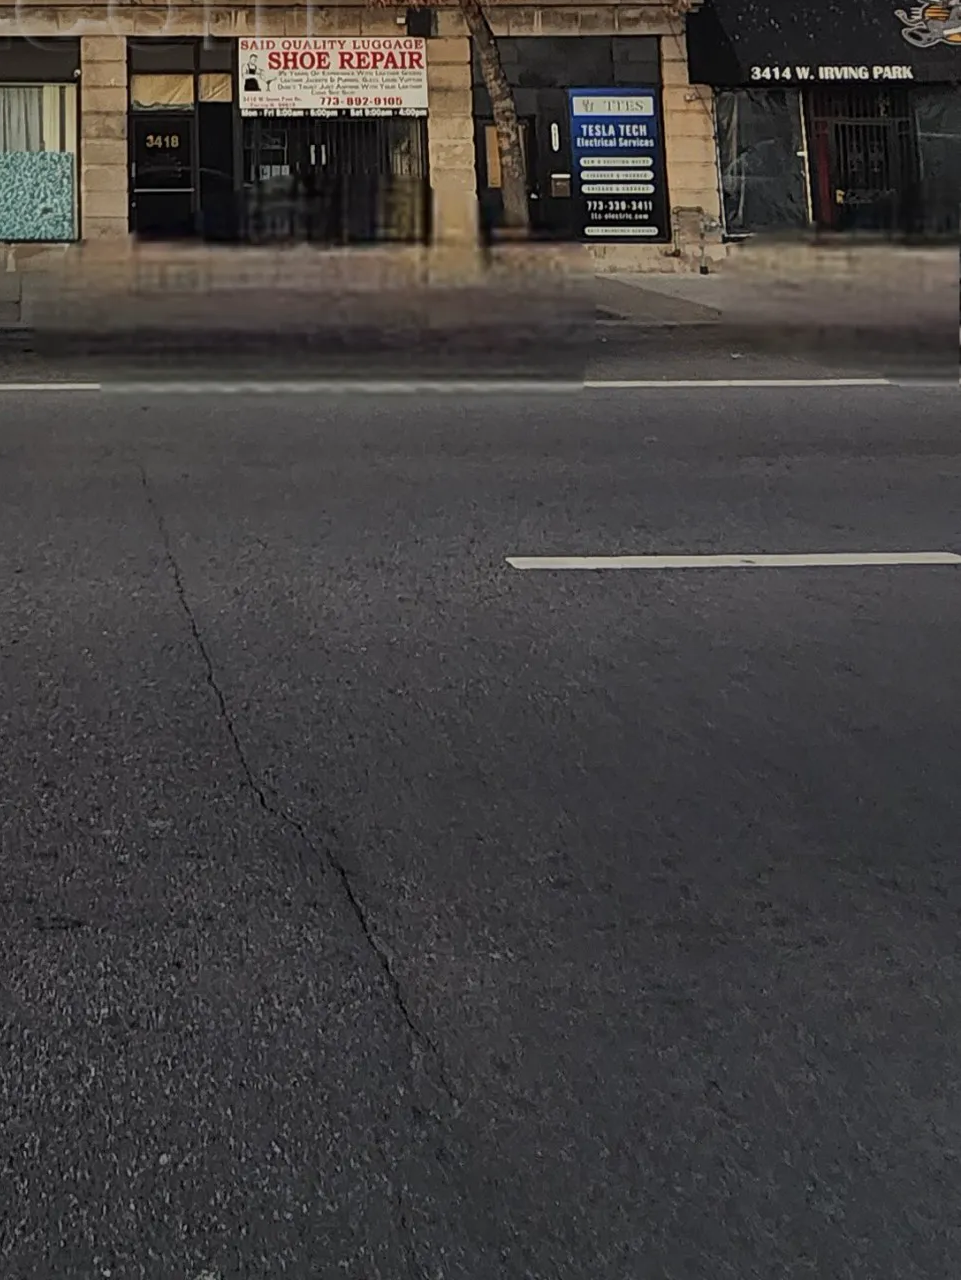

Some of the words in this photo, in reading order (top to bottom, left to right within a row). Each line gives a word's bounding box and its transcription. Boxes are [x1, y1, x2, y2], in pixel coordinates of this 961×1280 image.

[240, 39, 276, 50] SAID
[281, 39, 347, 51] QUALITY
[352, 39, 424, 50] LUGGAGE
[268, 51, 331, 70] SHOE
[338, 51, 425, 70] REPAIR
[751, 66, 792, 80] 3414
[795, 66, 815, 80] W.
[818, 65, 870, 80] IRVING
[873, 65, 914, 80] PARK
[241, 108, 258, 117] Mon
[264, 108, 275, 117] Fri
[398, 108, 427, 118] 4:00pm
[580, 124, 616, 136] TESLA
[618, 124, 647, 136] TECH
[145, 134, 180, 148] 3418
[576, 137, 617, 147] Electrical
[618, 138, 655, 147] Services
